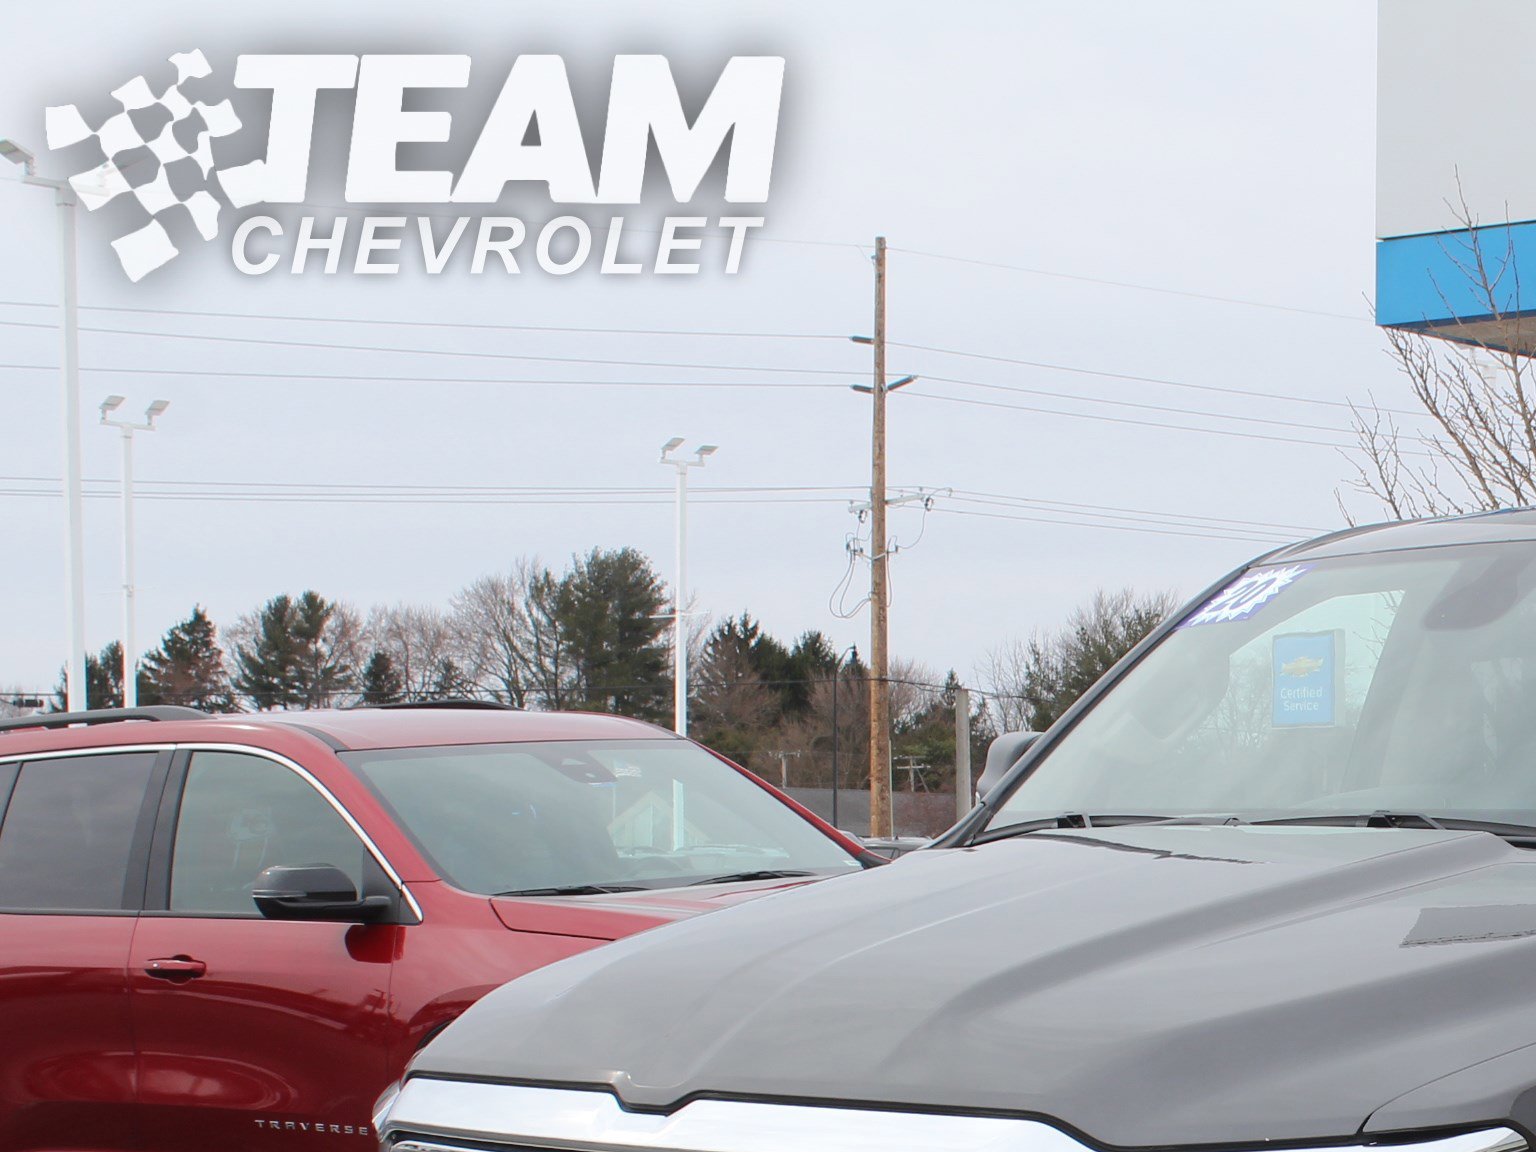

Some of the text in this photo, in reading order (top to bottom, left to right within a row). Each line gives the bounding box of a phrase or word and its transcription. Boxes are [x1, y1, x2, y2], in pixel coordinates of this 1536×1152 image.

[1280, 687, 1323, 699] Certified
[1283, 700, 1319, 712] Service
[254, 1119, 369, 1136] TRAVERSE
